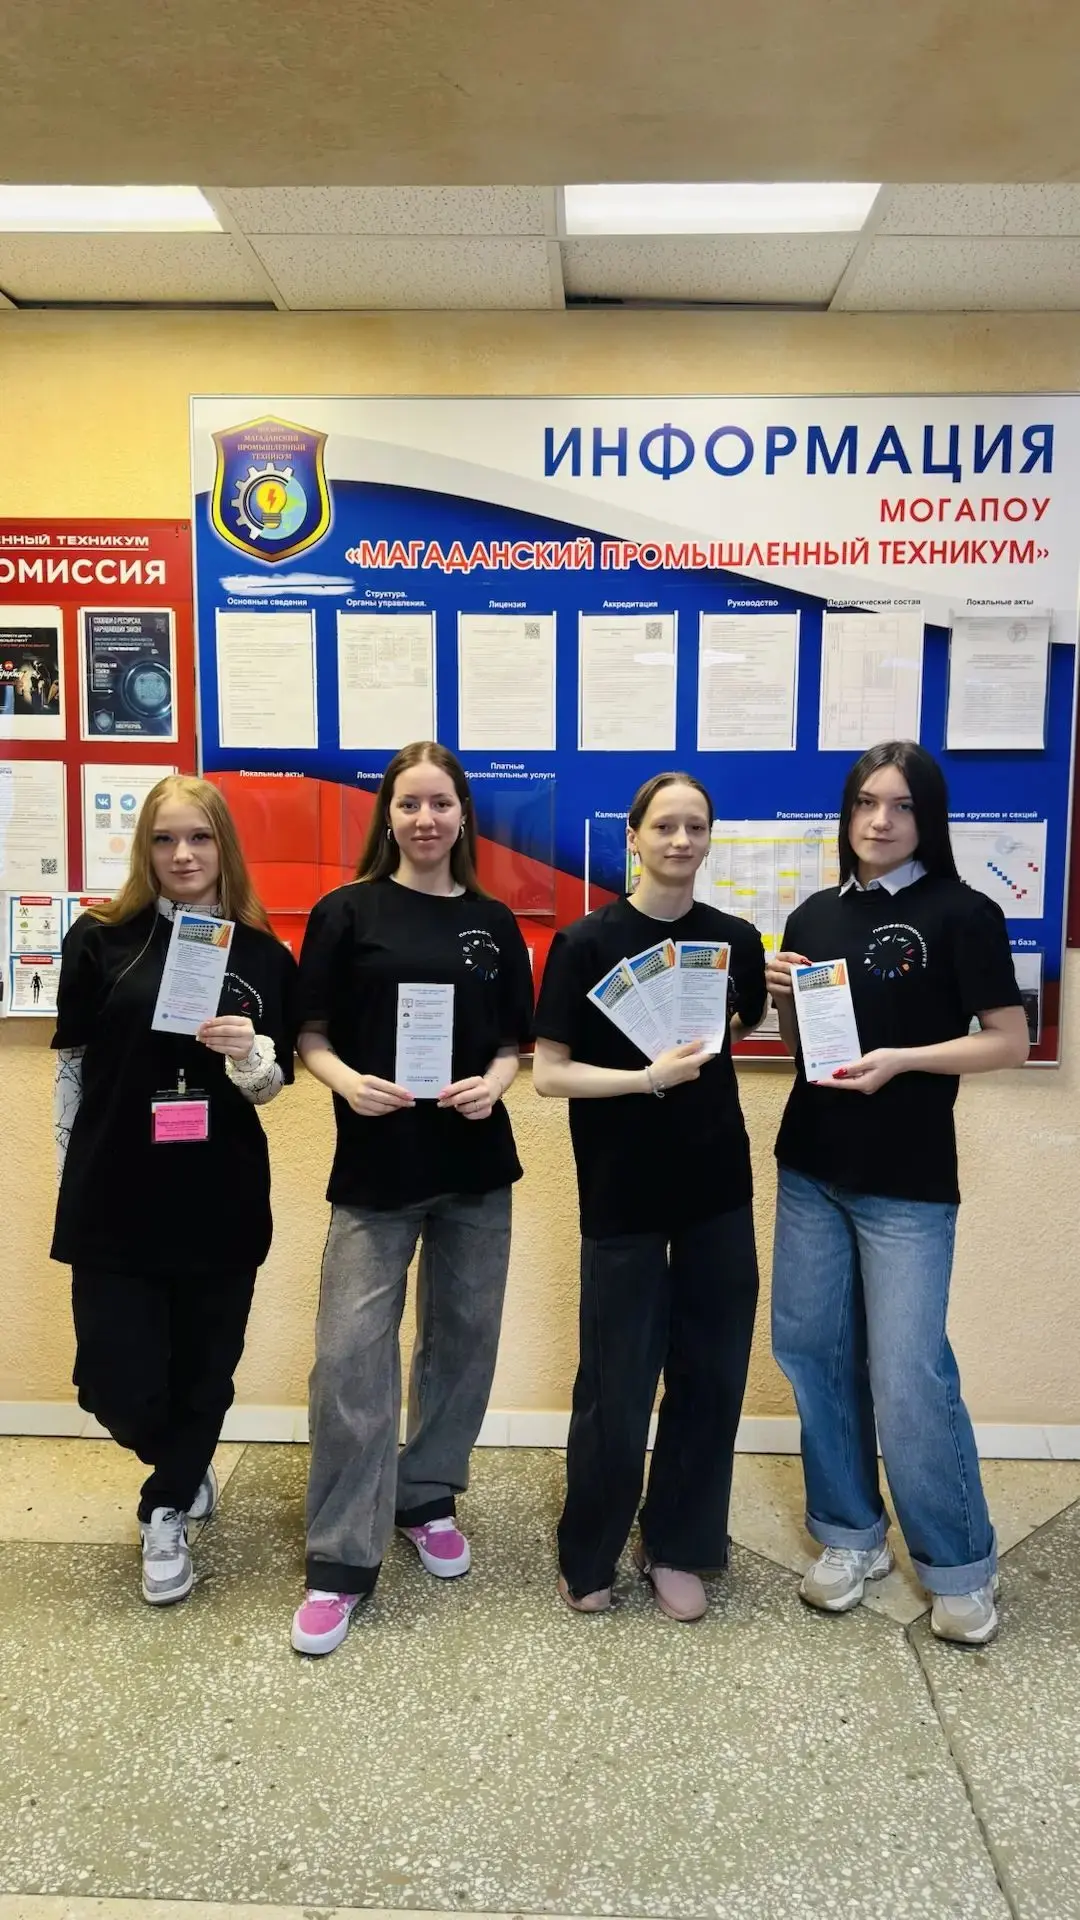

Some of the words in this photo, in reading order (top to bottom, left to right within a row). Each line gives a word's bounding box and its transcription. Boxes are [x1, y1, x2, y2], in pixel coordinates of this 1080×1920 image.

[544, 422, 1054, 483] ИНФОРМАЦИЯ
[880, 498, 1051, 522] МОГАПОУ
[0, 534, 51, 545] ННЫЙ
[57, 535, 149, 546] ТЕХНИКУМ
[346, 538, 594, 573] «МАГАДАНСКИЙ
[601, 537, 870, 569] ПРОМЫШЛЕННЫЙ
[878, 540, 1050, 565] ТЕХНИКУМ»
[0, 558, 166, 584] ОМИССИЯ
[365, 590, 408, 599] Структура.
[227, 597, 269, 606] Основные
[270, 598, 308, 607] сведения
[346, 599, 377, 608] Органы
[378, 599, 427, 608] управления.
[489, 600, 527, 609] Лицензия
[603, 600, 659, 609] Аккредитация
[727, 599, 779, 608] Руководство
[828, 598, 892, 608] Педагогический
[490, 762, 525, 770] Платные
[240, 769, 284, 778] Локальные
[357, 771, 385, 779] Локаль
[464, 770, 529, 779] бразовательные
[530, 772, 556, 780] услуги
[595, 810, 630, 820] Календа
[776, 811, 824, 819] Расписание
[967, 812, 1001, 820] кружков
[1009, 811, 1038, 820] секций
[872, 923, 928, 969] ПРОФЕССИОНАЛИТЕТ
[1017, 938, 1037, 946] база
